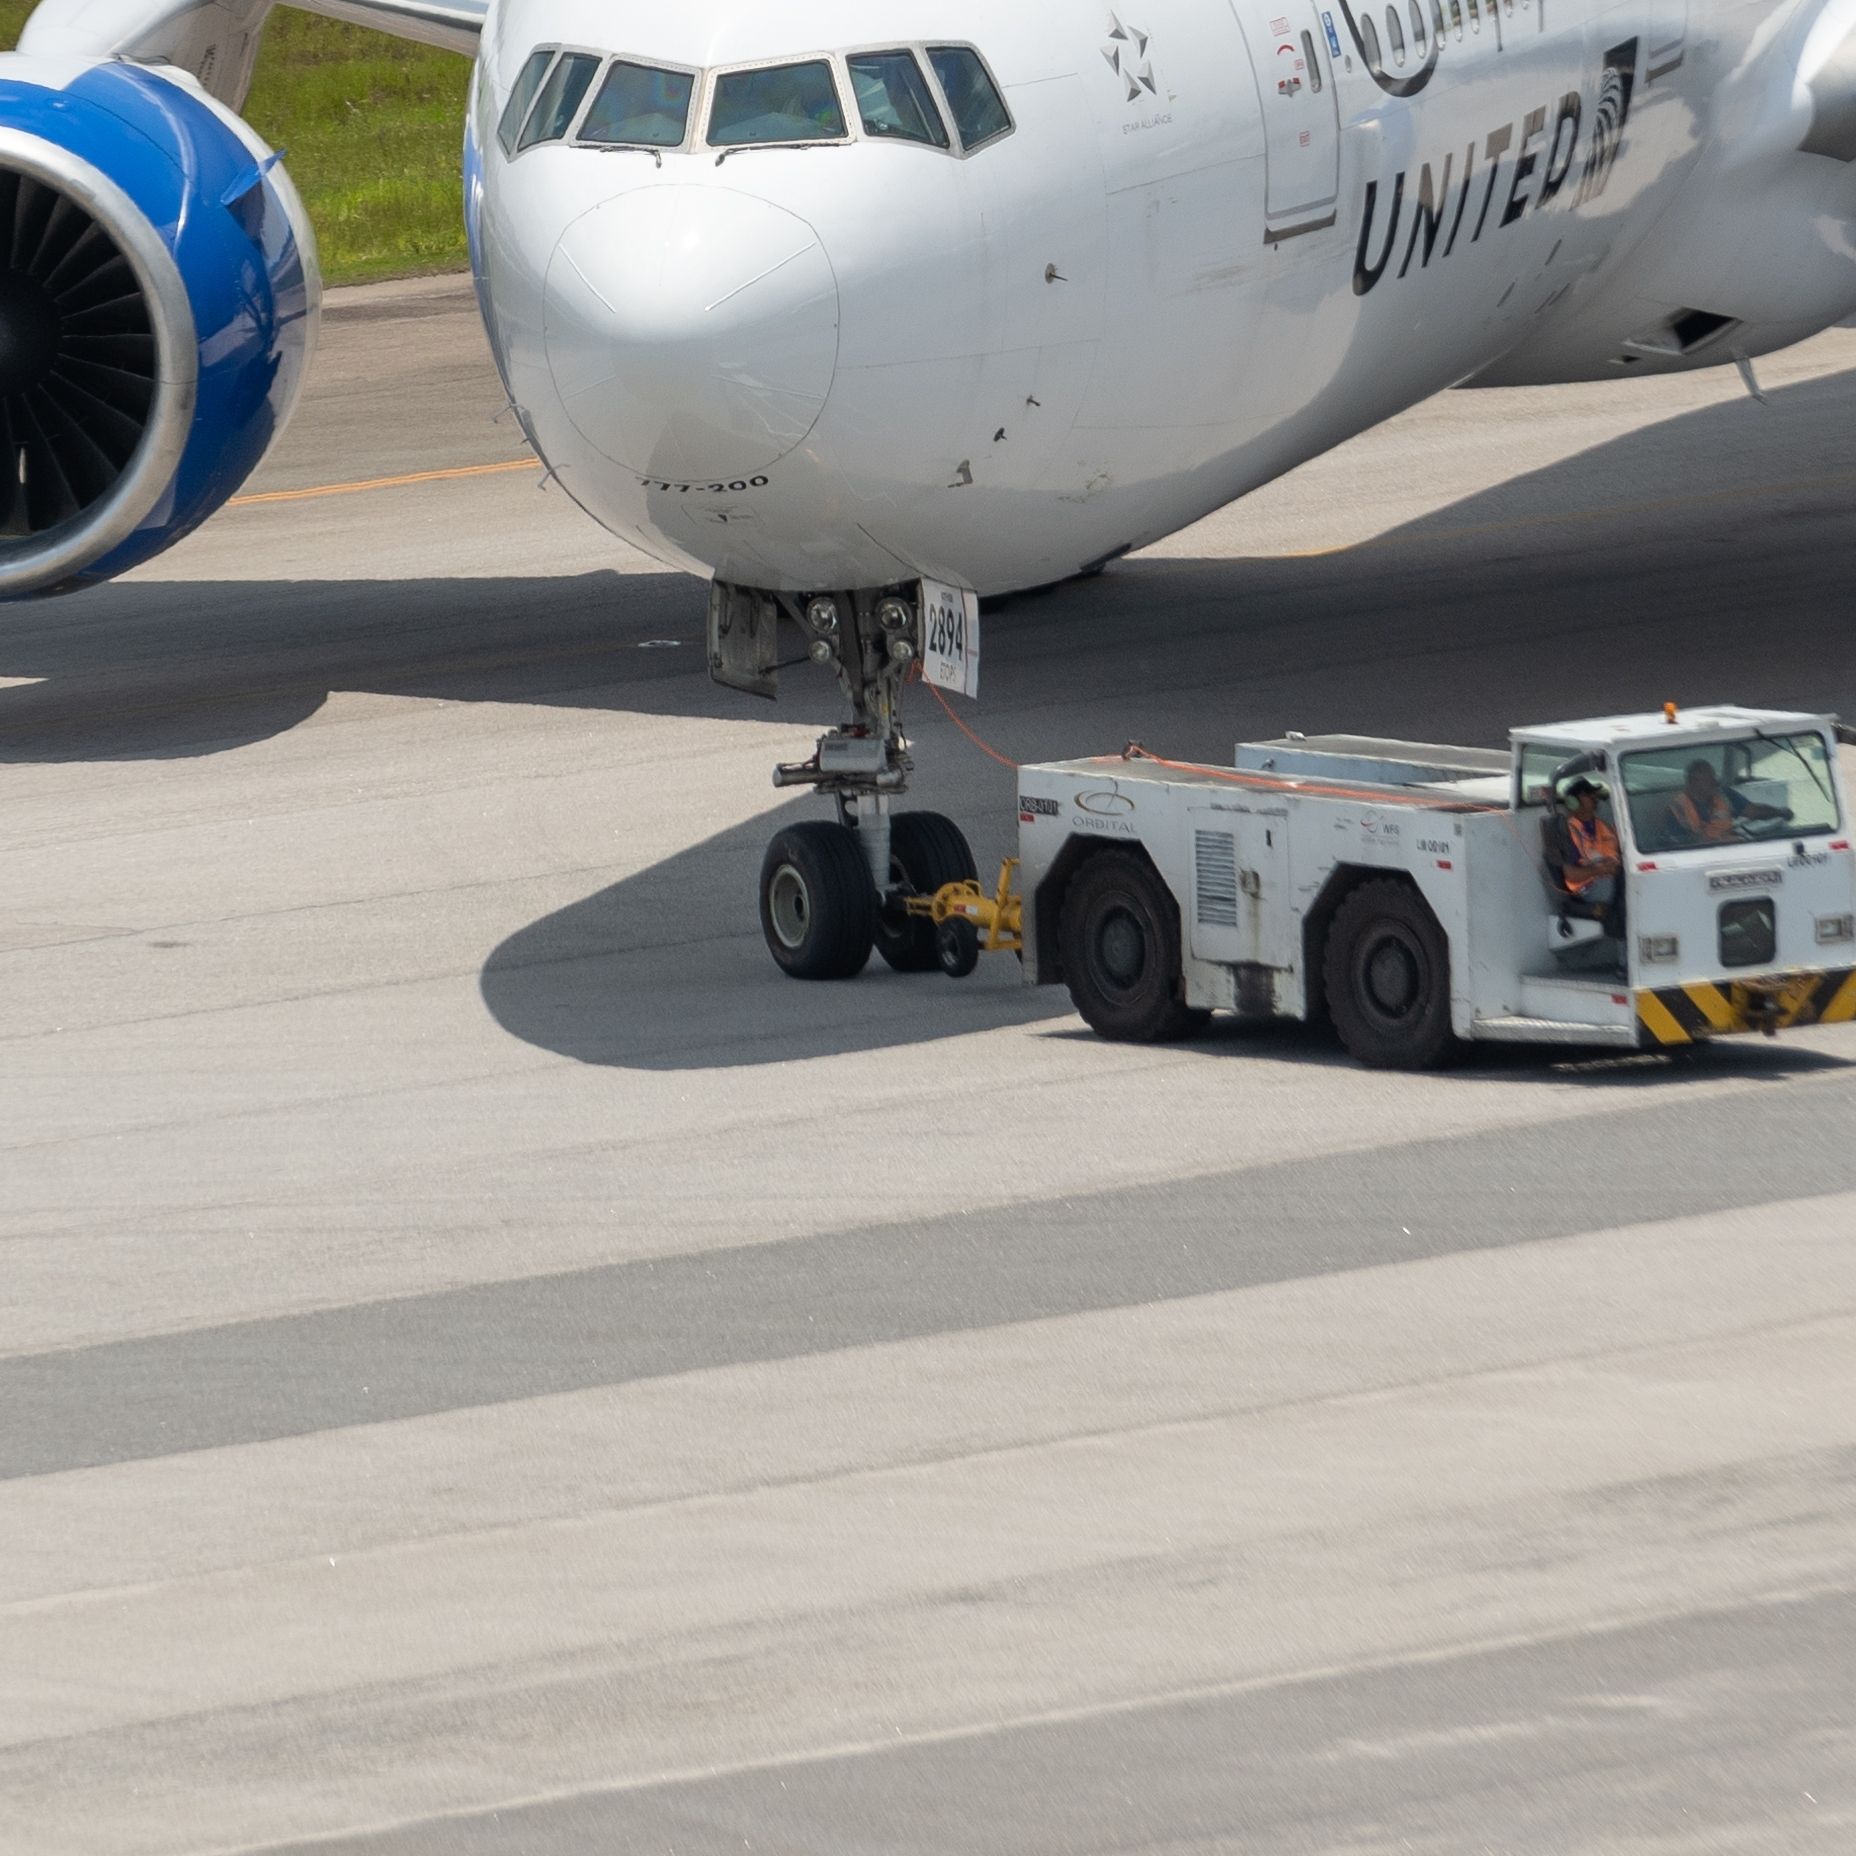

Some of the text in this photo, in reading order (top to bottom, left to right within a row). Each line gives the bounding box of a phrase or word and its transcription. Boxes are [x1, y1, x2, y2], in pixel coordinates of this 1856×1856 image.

[1352, 90, 1582, 296] UNITED
[635, 475, 768, 492] 777-200
[929, 603, 962, 662] 2894
